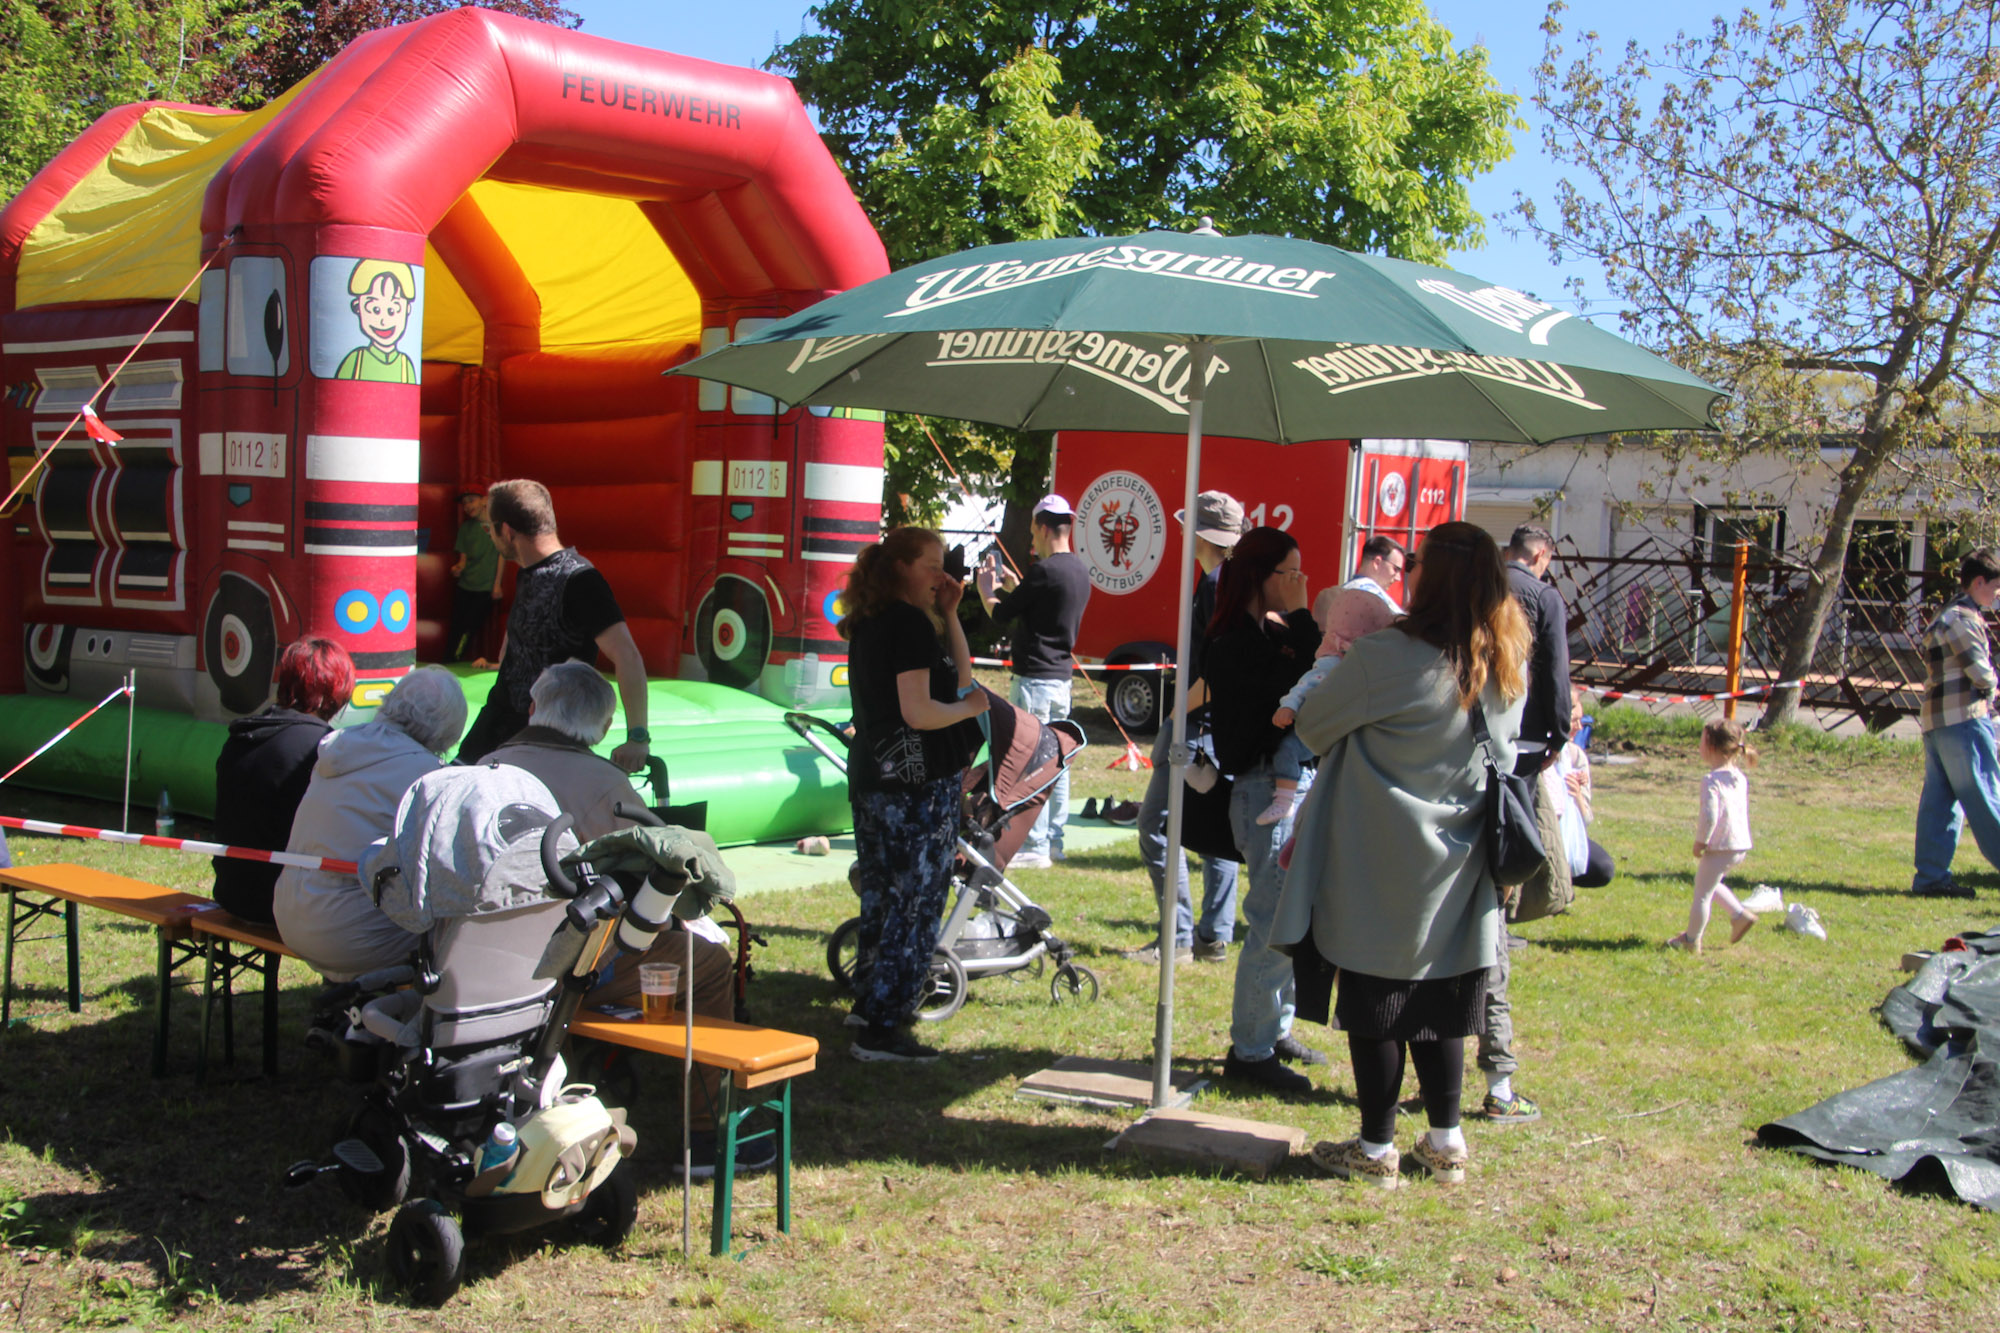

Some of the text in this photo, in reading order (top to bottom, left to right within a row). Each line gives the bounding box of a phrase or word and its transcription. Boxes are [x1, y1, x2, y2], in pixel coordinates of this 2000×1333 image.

[562, 72, 741, 130] FEUERWEHR
[904, 245, 1337, 308] Wernesgrüner
[1078, 476, 1162, 535] JUGENDFEUERWEHR
[1427, 488, 1445, 505] 112
[1089, 566, 1143, 589] COTTBUS
